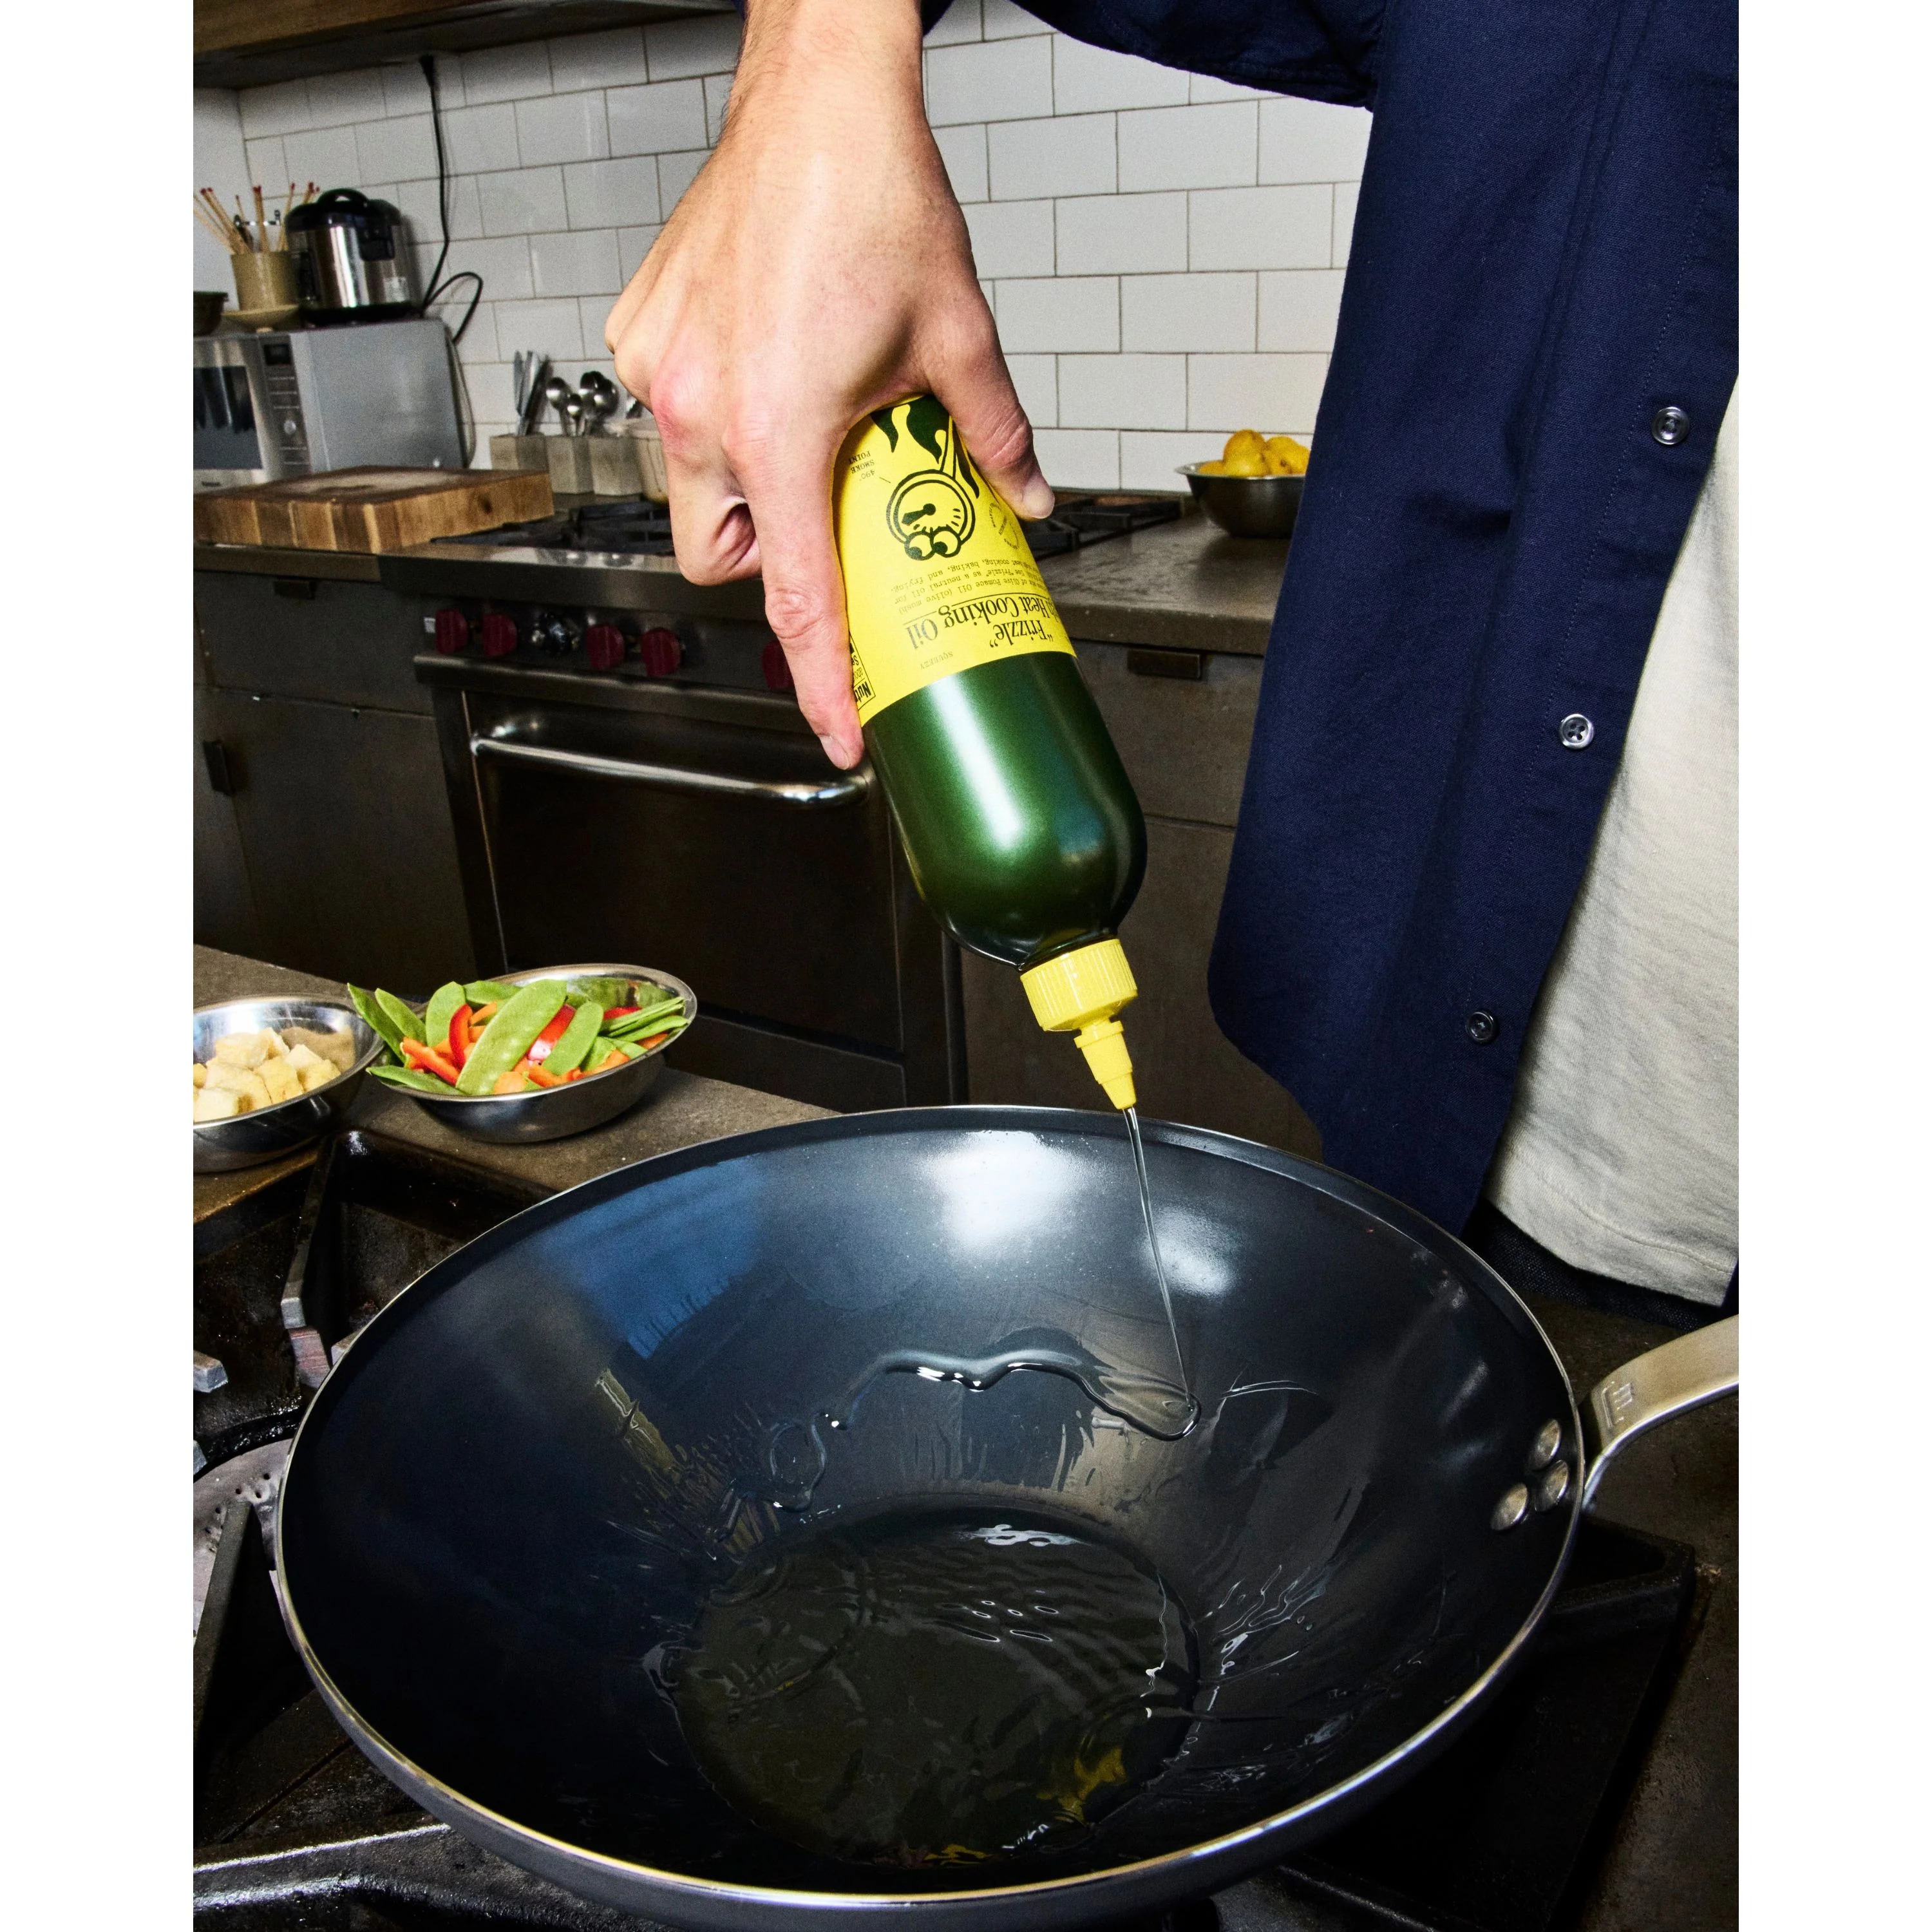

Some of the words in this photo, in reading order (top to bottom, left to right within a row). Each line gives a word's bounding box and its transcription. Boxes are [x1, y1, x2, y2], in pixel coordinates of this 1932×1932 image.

[848, 451, 871, 465] POINT
[850, 459, 875, 474] SMOKE
[927, 570, 943, 581] and
[975, 578, 1001, 587] Pomace
[891, 577, 923, 592] frying.
[929, 576, 961, 591] neutral
[912, 587, 925, 598] oil
[926, 589, 952, 602] (olive
[899, 600, 922, 615] mush)
[938, 596, 1019, 629] Cooking
[1019, 596, 1050, 618] Heat
[905, 618, 938, 650] Oil
[920, 650, 953, 670] SQUEEZY
